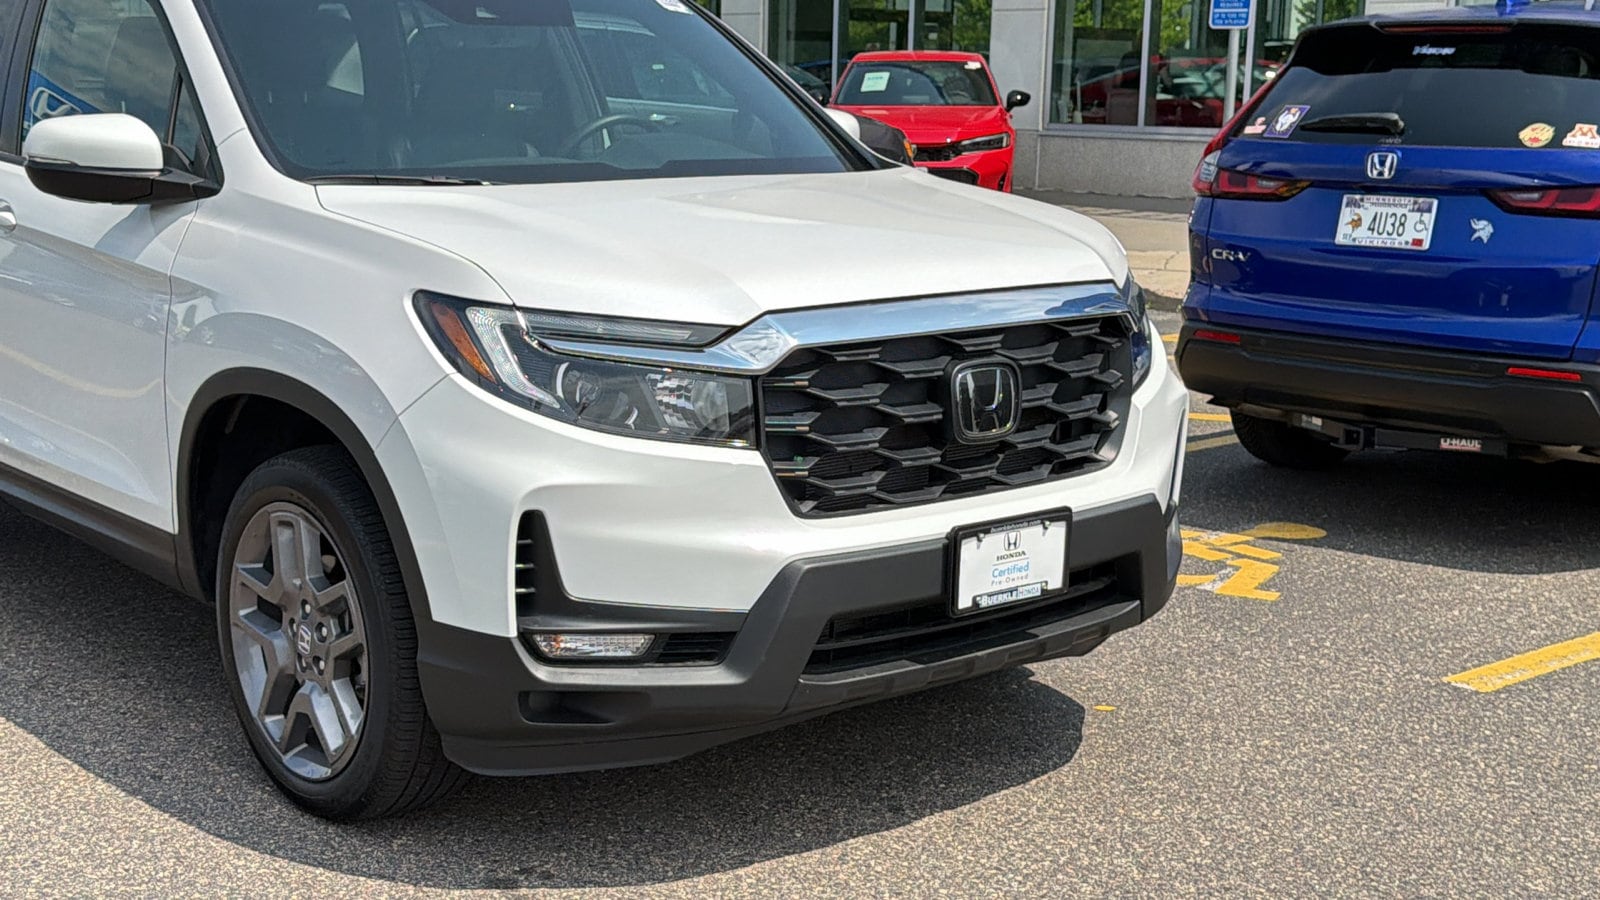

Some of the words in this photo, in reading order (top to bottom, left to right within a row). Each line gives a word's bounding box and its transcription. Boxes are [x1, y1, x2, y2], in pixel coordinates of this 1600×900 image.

[1366, 196, 1412, 204] MINNESOTA
[1367, 211, 1407, 237] 4U38
[1212, 248, 1251, 261] CR-V
[1440, 437, 1482, 448] U-HAUL
[996, 550, 1026, 561] HONDA
[992, 561, 1030, 578] Certified
